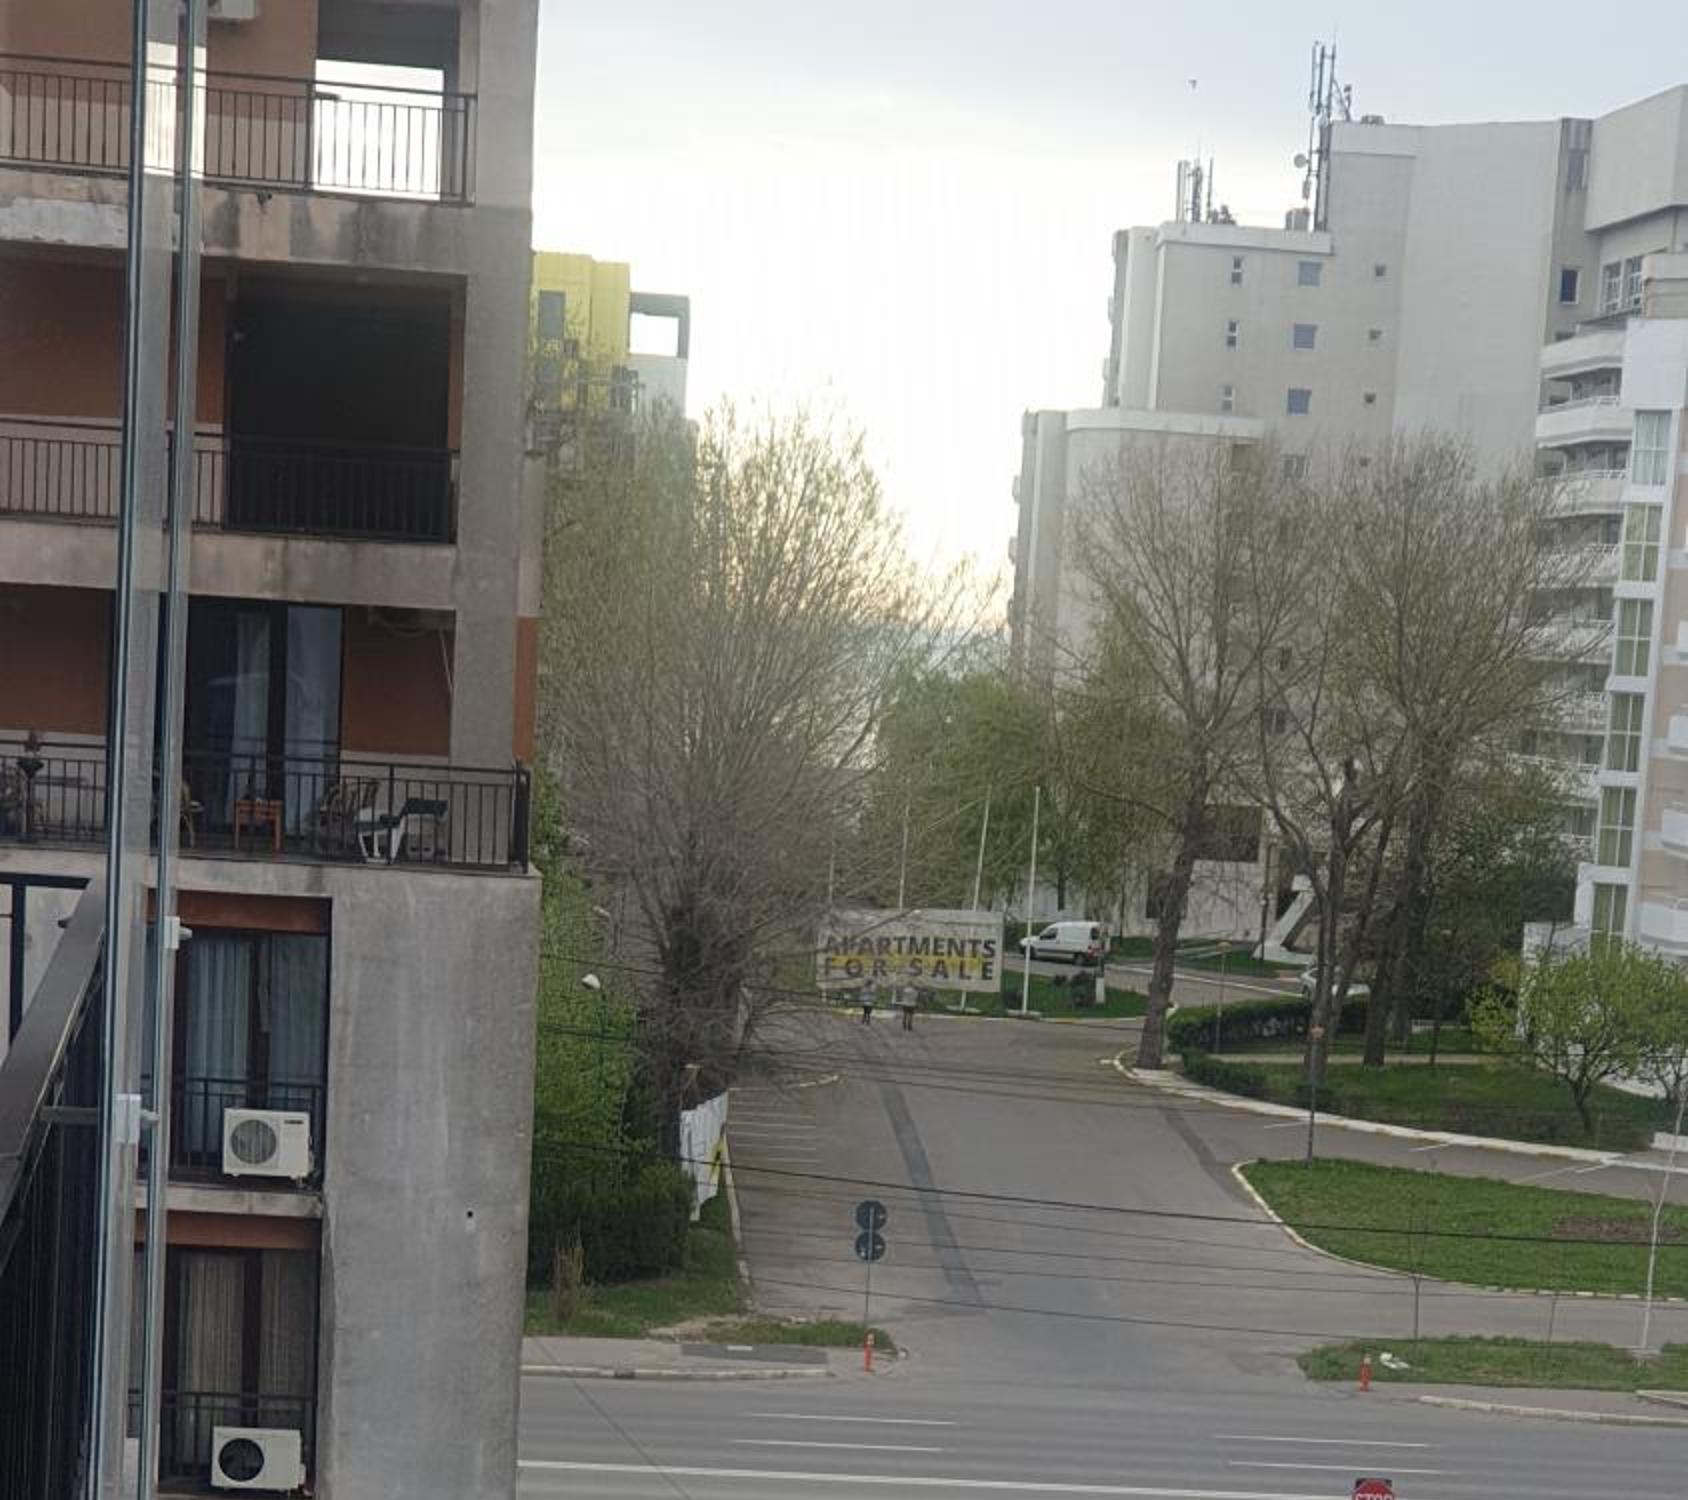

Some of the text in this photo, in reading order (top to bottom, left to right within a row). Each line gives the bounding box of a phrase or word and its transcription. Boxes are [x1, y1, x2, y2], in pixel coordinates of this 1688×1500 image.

[825, 935, 997, 959] APARTMENTS
[824, 957, 994, 981] FOR SALE
